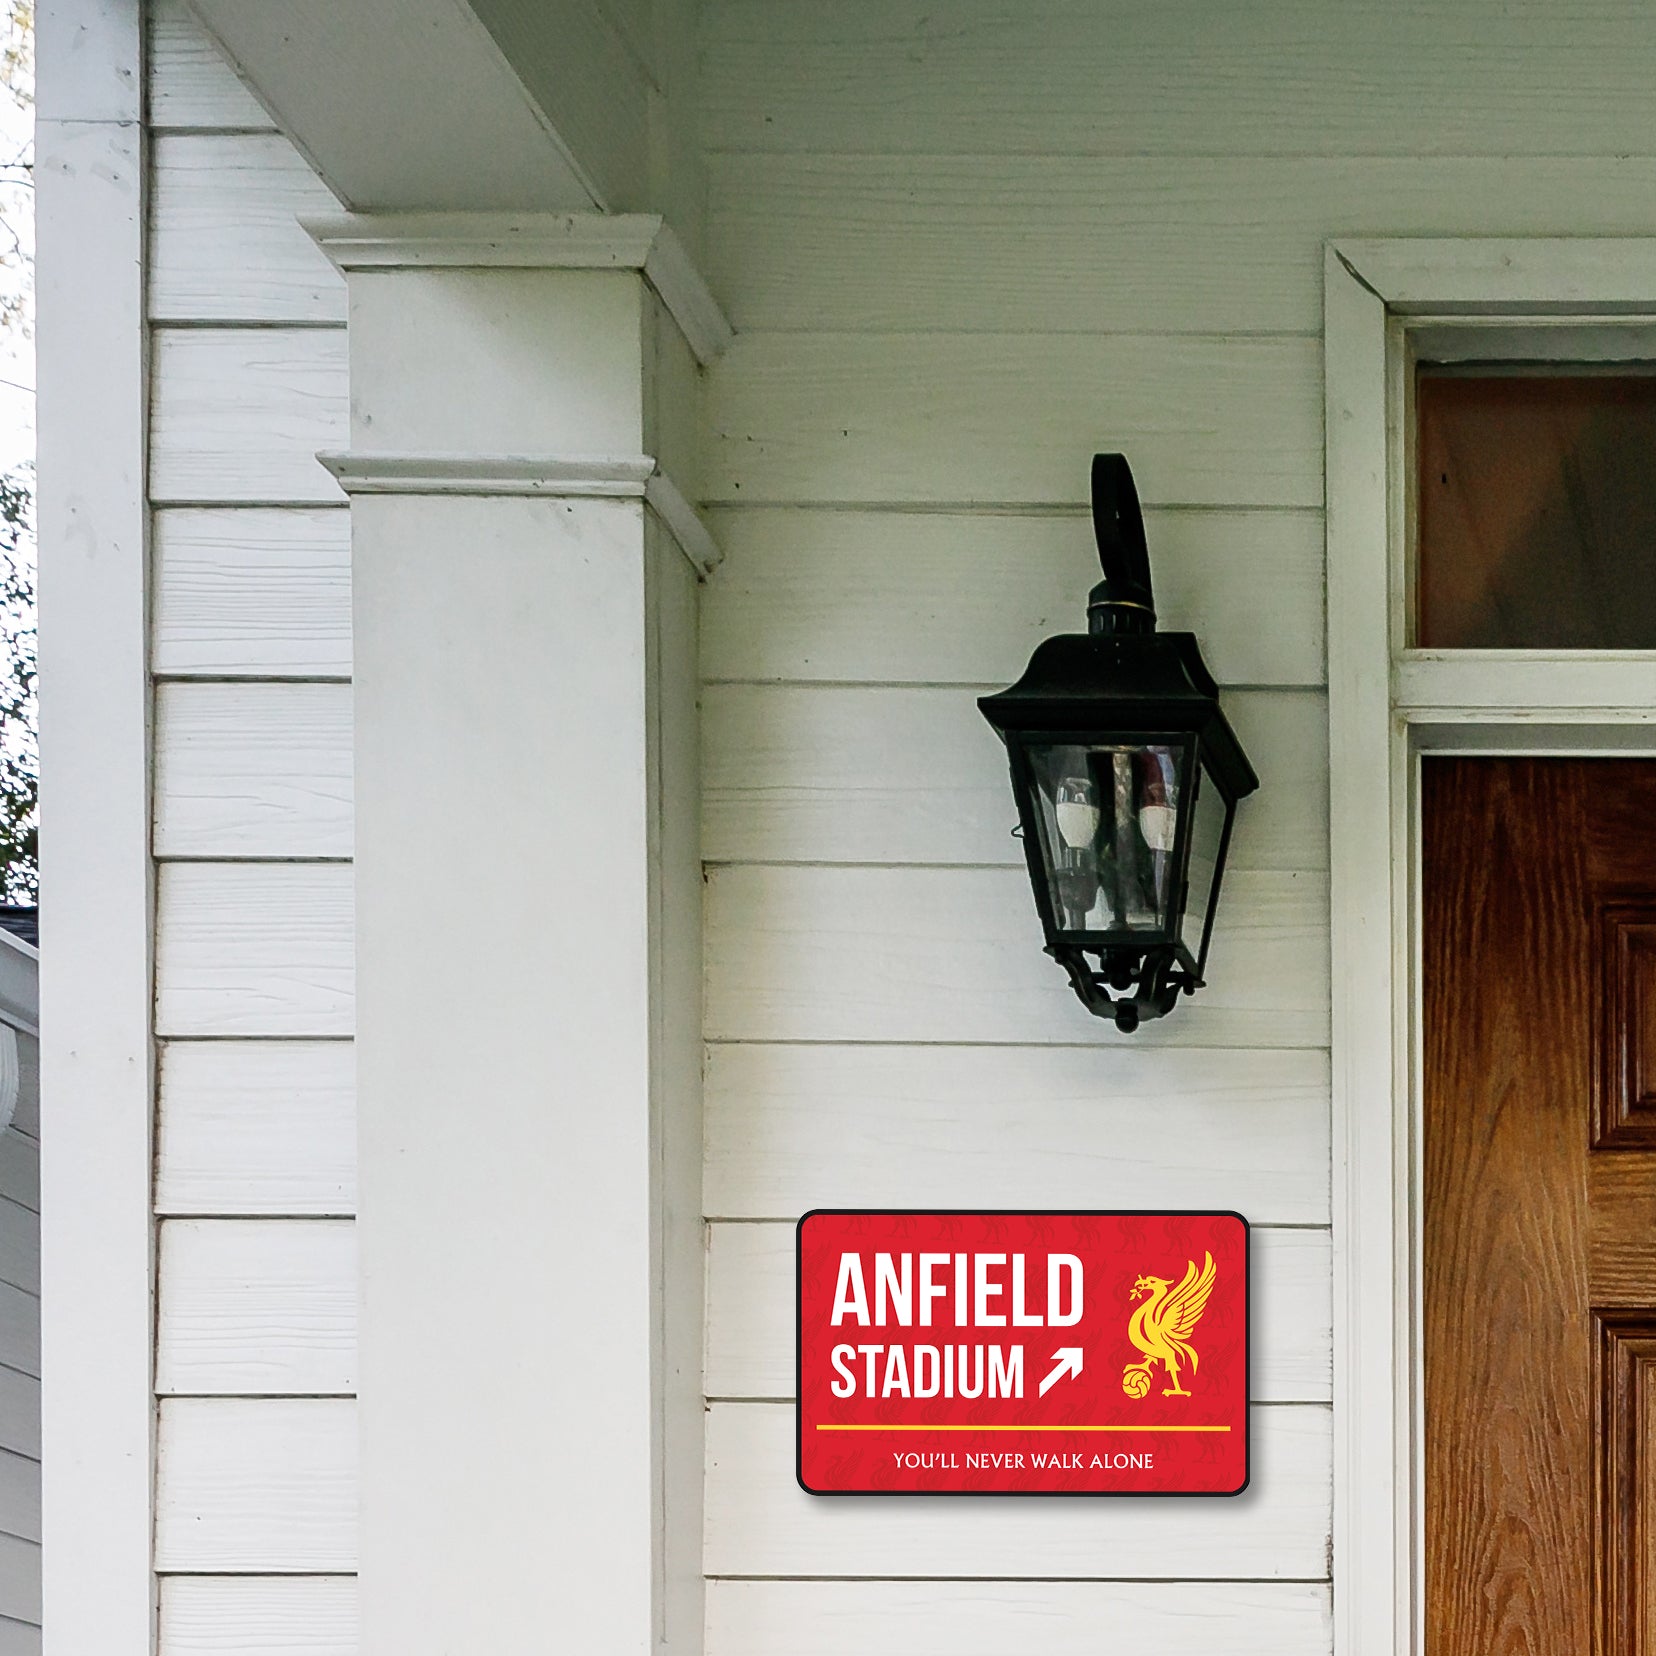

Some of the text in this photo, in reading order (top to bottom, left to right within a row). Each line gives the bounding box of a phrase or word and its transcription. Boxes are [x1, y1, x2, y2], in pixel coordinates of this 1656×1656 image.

[831, 1253, 1083, 1326] ANFIELD
[831, 1344, 1023, 1398] STADIUM
[894, 1453, 1153, 1468] YOU’LL NEVER WALK ALONE
